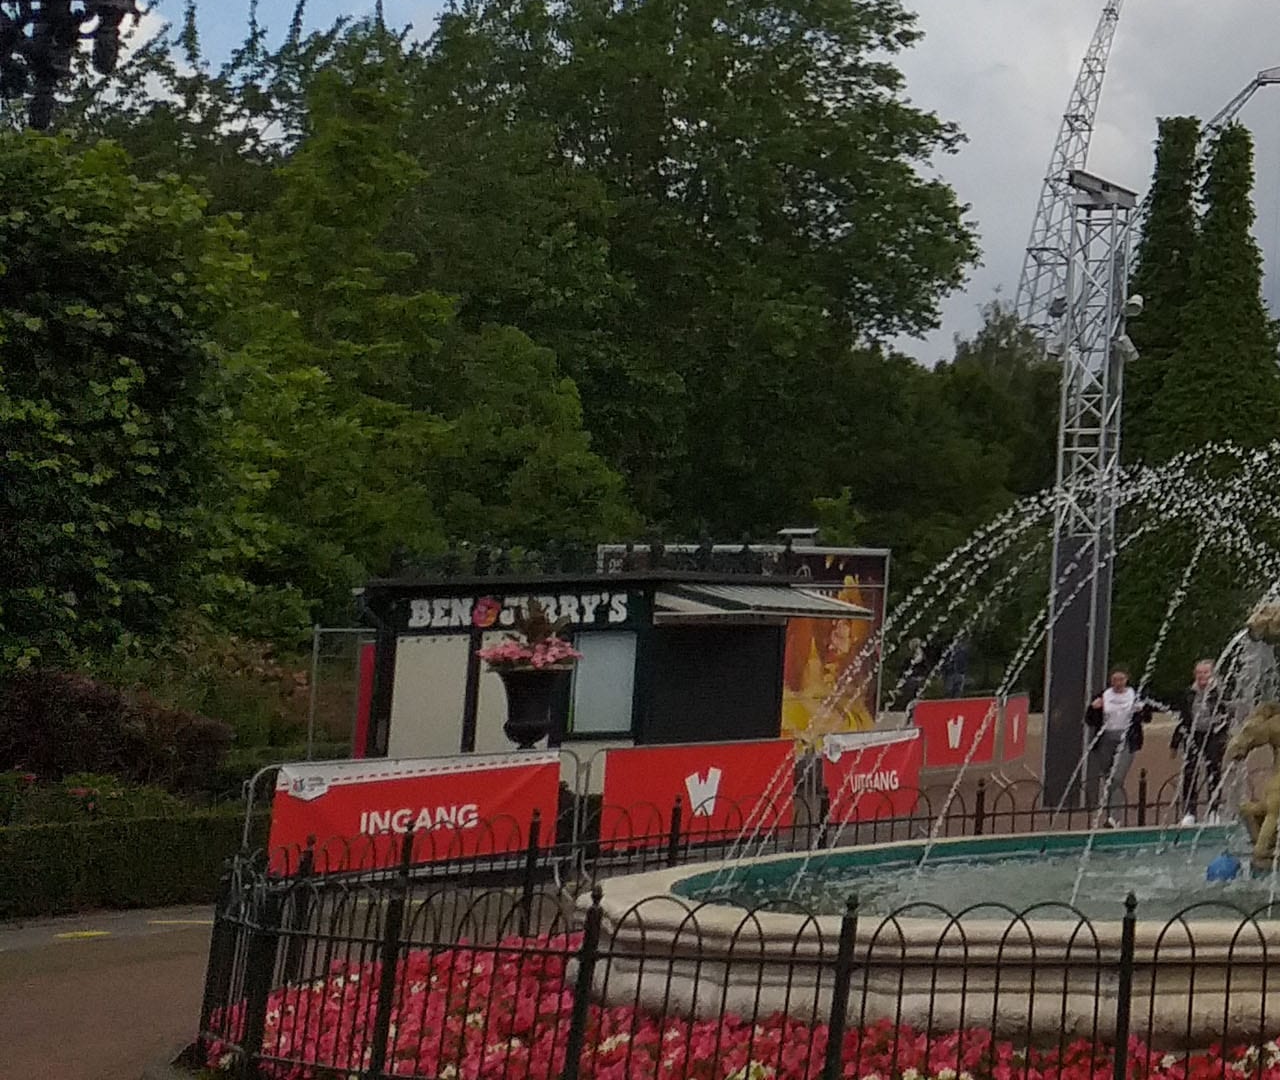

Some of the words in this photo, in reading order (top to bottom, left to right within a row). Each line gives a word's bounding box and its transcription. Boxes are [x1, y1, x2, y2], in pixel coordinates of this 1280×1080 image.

[408, 598, 473, 627] BEN
[684, 766, 722, 816] W
[850, 770, 899, 793] UITGANG
[360, 804, 479, 835] INGANG
